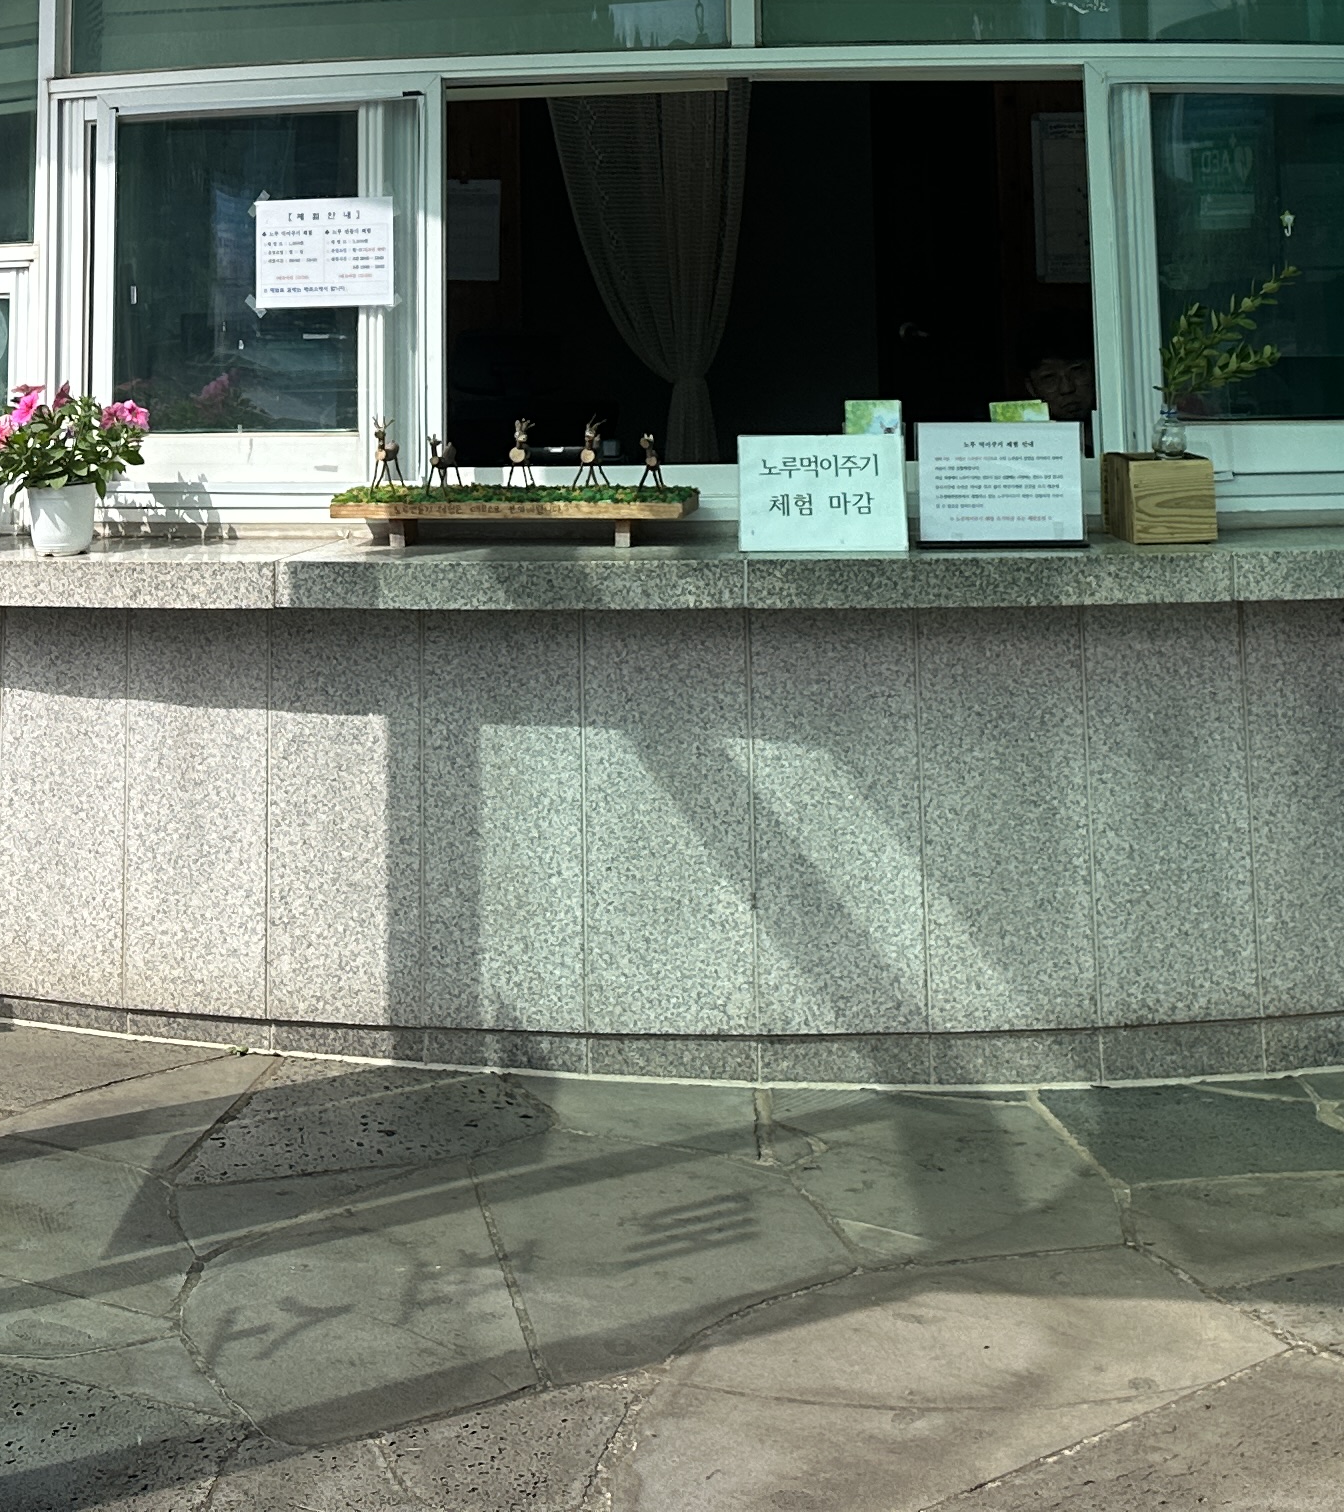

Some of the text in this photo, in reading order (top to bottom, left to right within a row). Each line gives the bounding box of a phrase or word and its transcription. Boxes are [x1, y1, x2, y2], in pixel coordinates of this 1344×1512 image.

[759, 453, 879, 479] 노루먹이주기
[769, 491, 875, 517] 체험 마감
